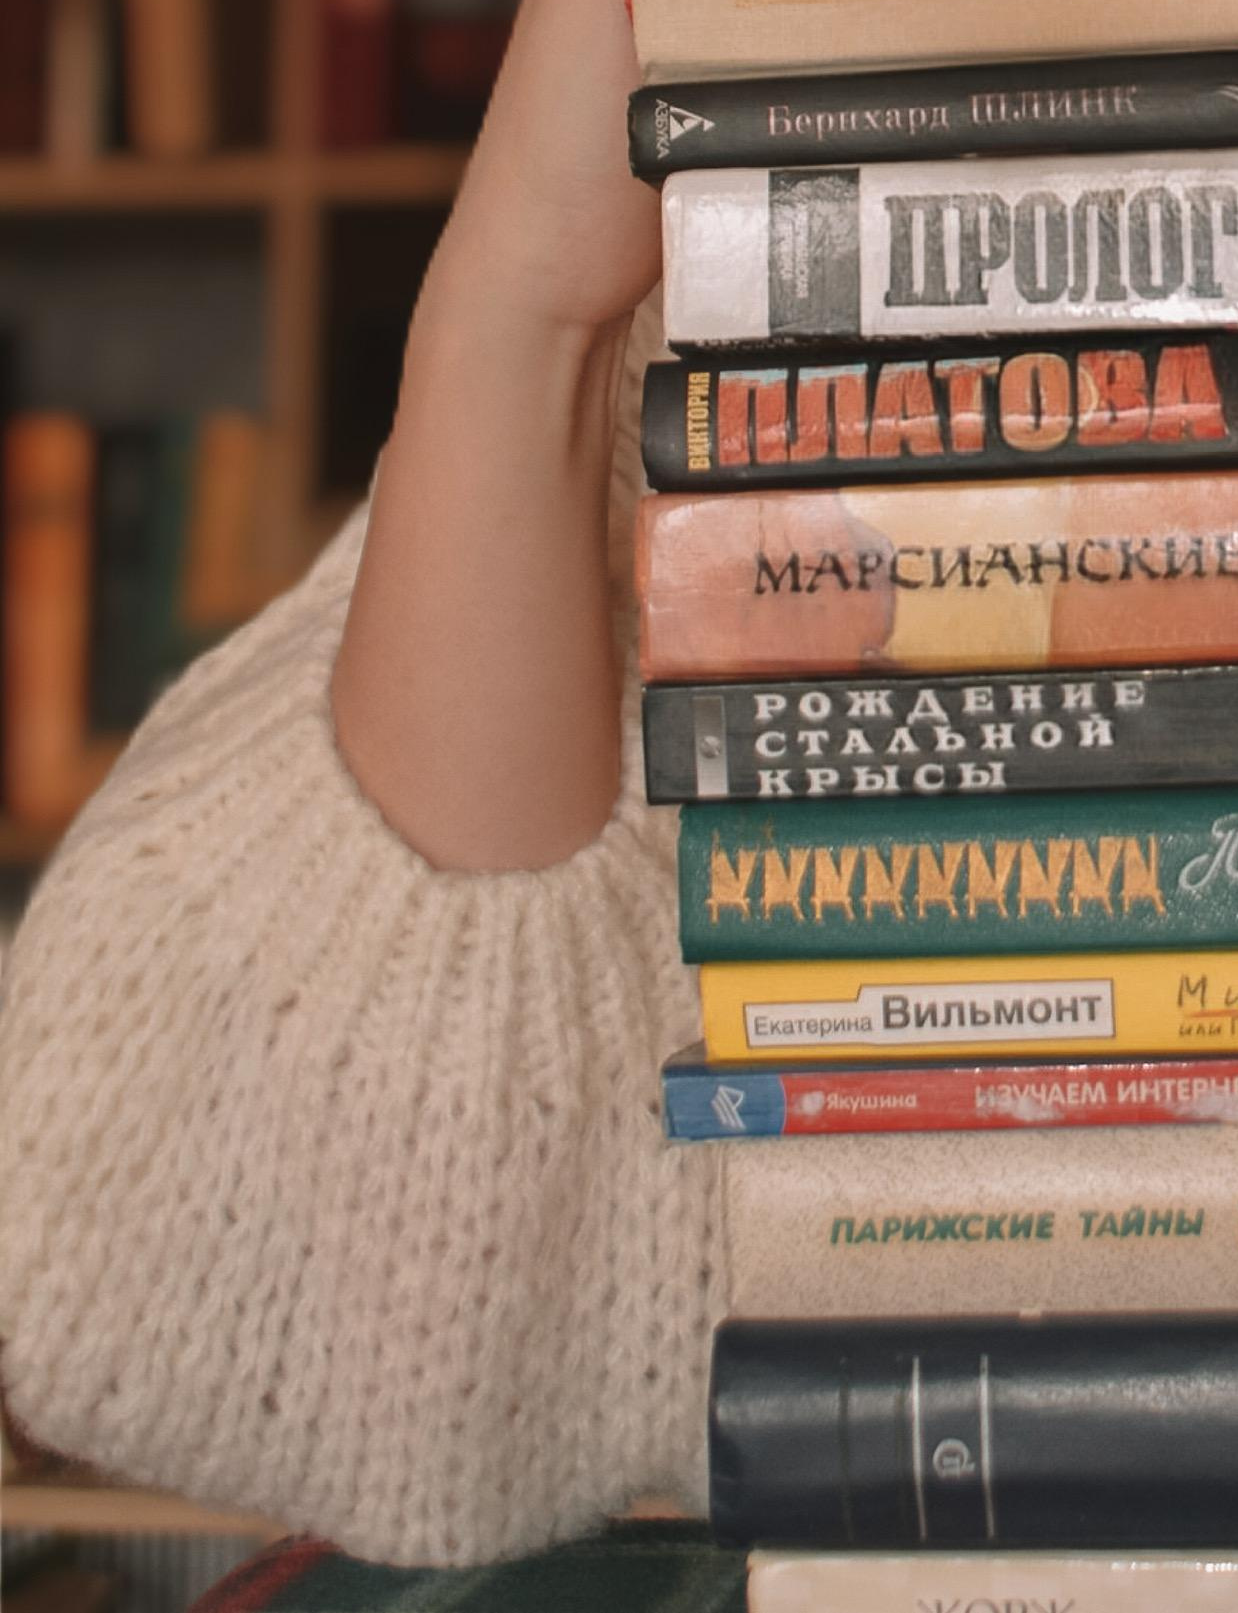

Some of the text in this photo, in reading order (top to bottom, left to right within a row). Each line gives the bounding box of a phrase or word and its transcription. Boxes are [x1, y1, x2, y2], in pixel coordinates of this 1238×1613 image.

[654, 98, 671, 160] АЗБУКА
[767, 85, 1140, 141] Бернхард ШЛИНК
[884, 186, 1238, 307] ПРОЛОГ
[687, 372, 711, 473] ВИКТОРИЯ
[717, 344, 1229, 468] ПЛАТОВА
[754, 680, 1146, 724] РОЖДЕНИЕ
[755, 713, 1116, 759] СТАЛЬНОЙ
[757, 761, 1007, 797] КРЫСЫ
[753, 993, 1103, 1040] Екатерина Вильмонт
[1179, 1019, 1222, 1038] или
[826, 1090, 918, 1115] Якушина
[829, 1208, 1206, 1245] ПАРИЖСКИЕ ТАЙНЫ
